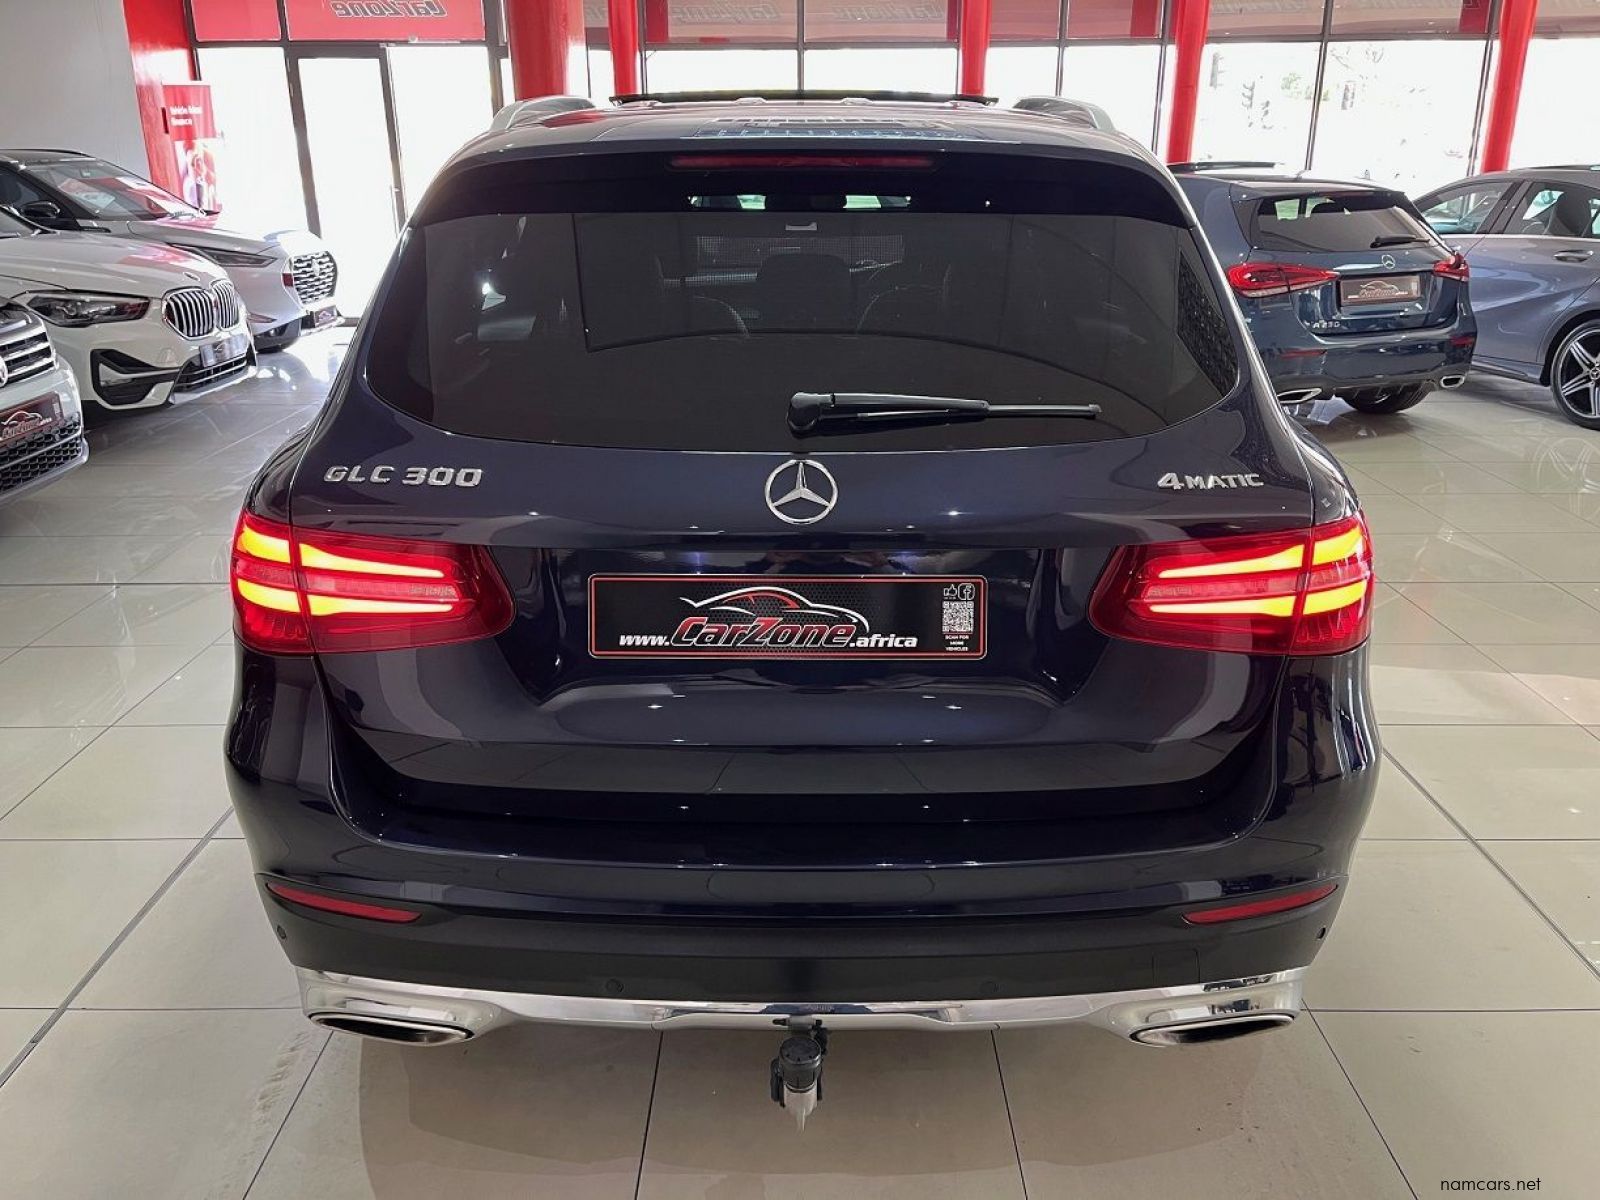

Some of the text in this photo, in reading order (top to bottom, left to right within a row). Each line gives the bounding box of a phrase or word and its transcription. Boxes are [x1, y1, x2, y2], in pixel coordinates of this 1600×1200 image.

[323, 465, 482, 487] GLC 300
[1157, 472, 1265, 490] 4MATIC
